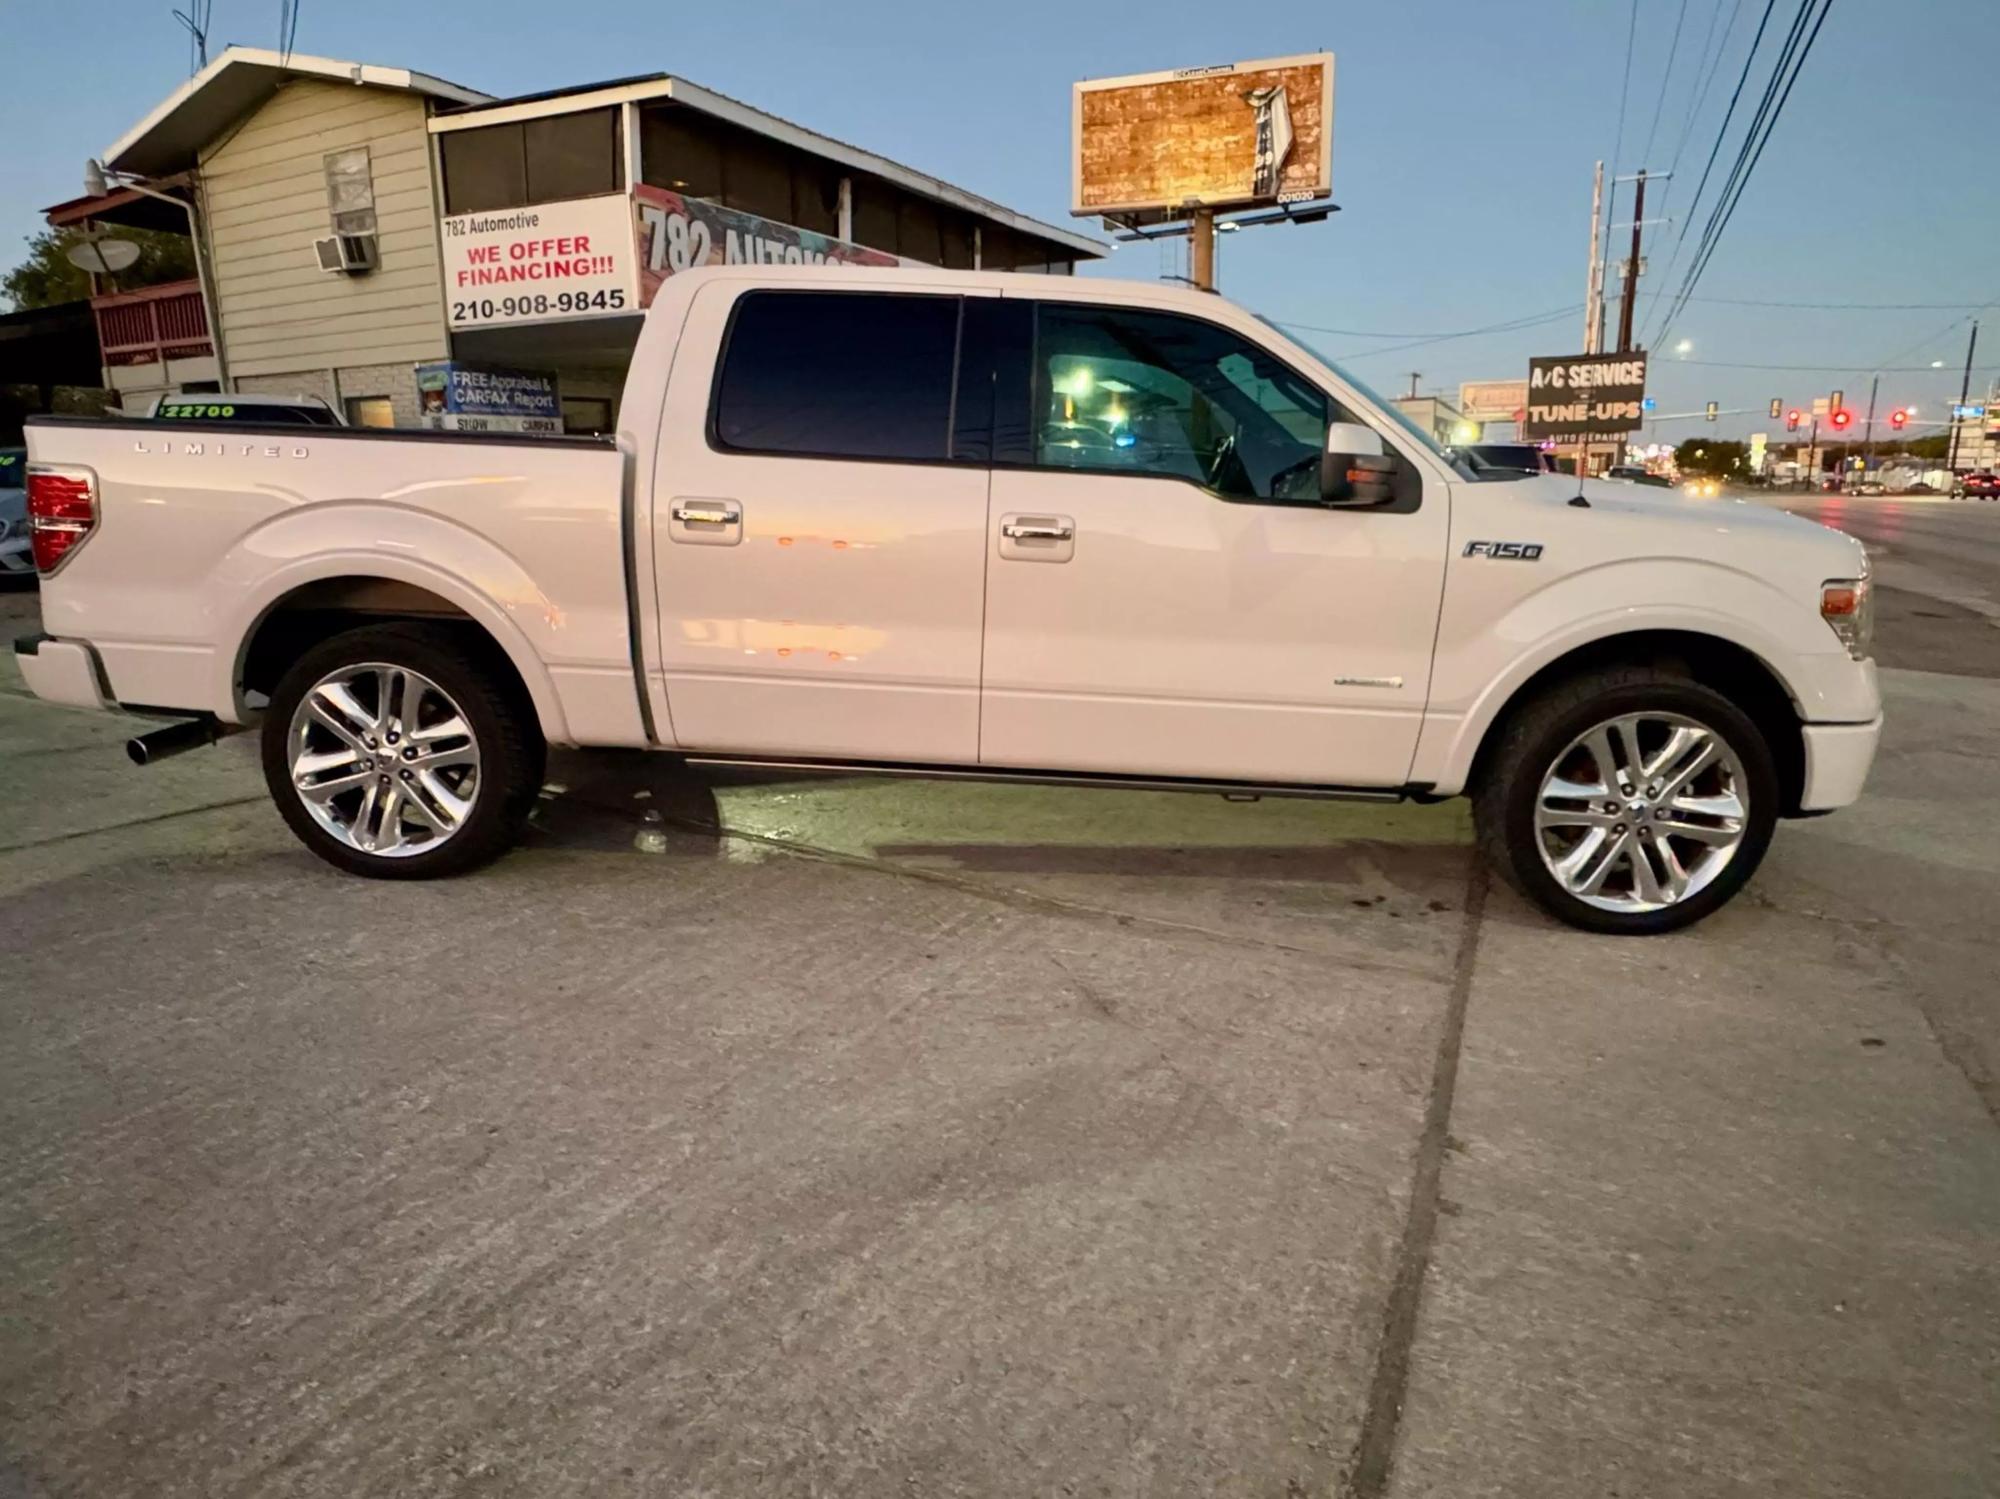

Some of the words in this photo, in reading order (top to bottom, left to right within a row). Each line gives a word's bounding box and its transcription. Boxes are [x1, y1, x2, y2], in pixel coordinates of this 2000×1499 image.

[445, 218, 466, 237] 782
[470, 211, 539, 233] Automotive
[467, 246, 501, 265] WE
[510, 236, 590, 260] OFFER
[640, 206, 711, 273] 782
[457, 256, 613, 287] FINANCING!!!
[453, 289, 625, 321] 210-908-9845
[453, 371, 487, 386] FREE
[490, 373, 541, 392] Appraisal
[1531, 366, 1565, 389] A/C
[1568, 361, 1645, 388] SERVICE
[455, 389, 509, 404] CARFAX
[514, 394, 553, 409] Report
[1530, 401, 1640, 423] TUNE-UPS
[135, 441, 309, 459] LIMITED
[1462, 541, 1544, 561] F-150
